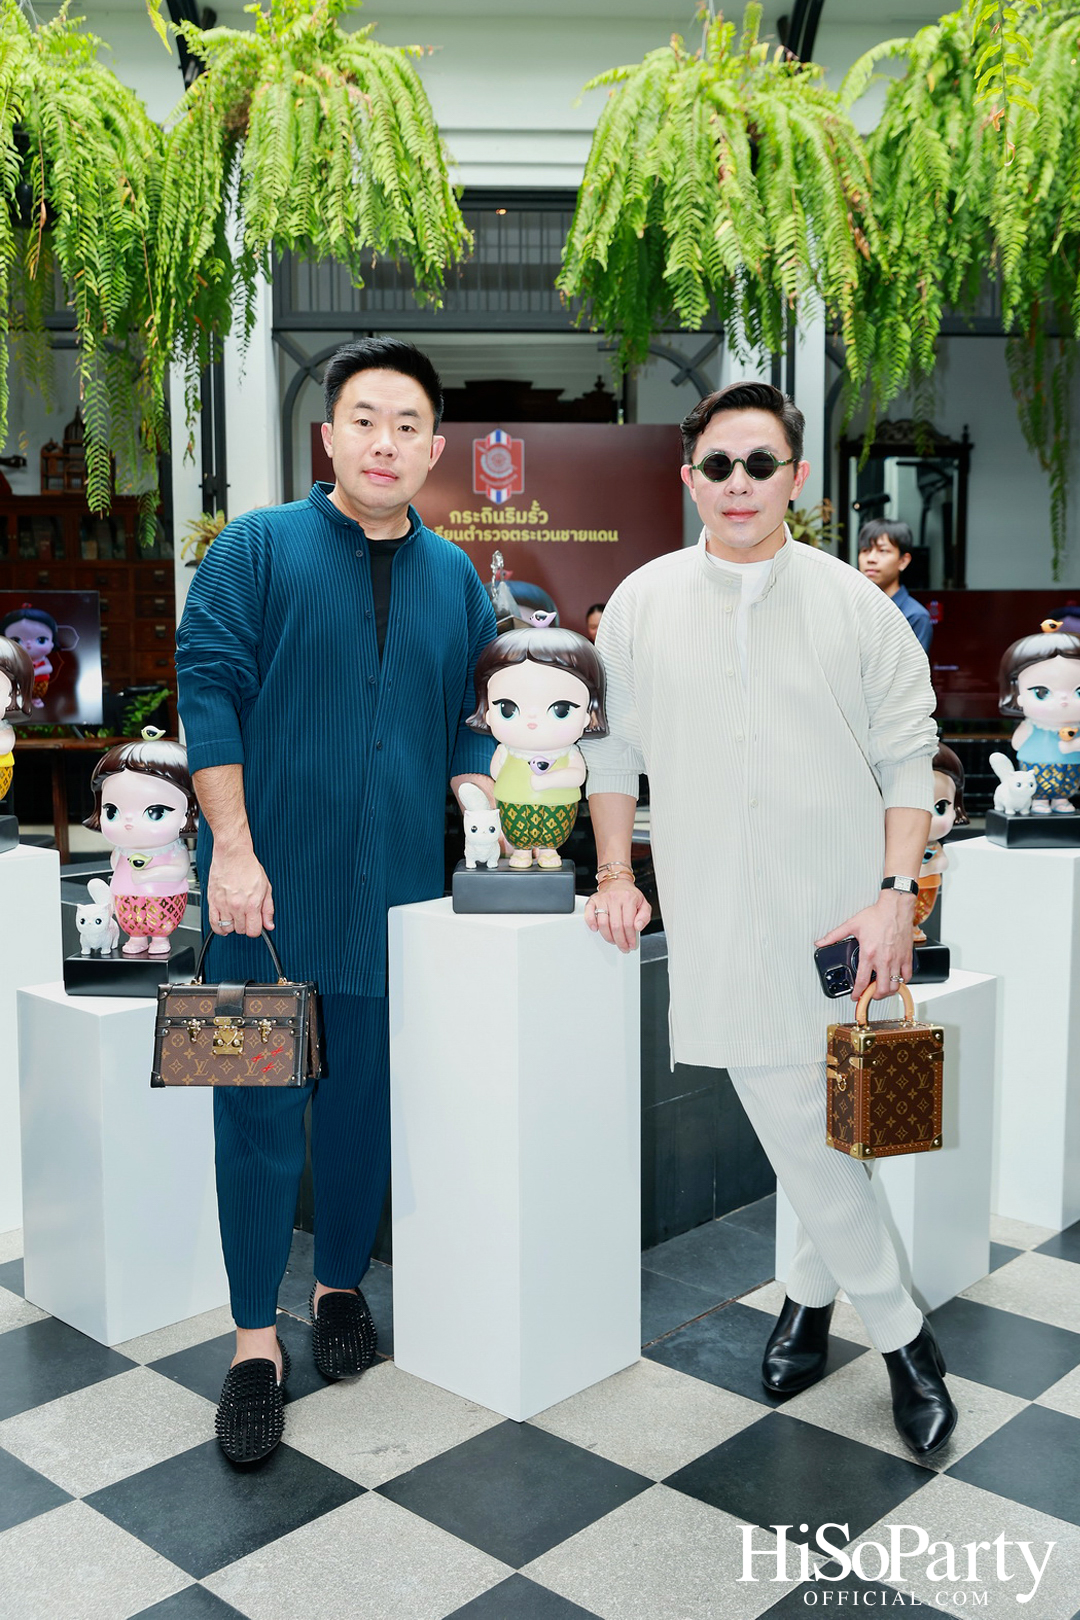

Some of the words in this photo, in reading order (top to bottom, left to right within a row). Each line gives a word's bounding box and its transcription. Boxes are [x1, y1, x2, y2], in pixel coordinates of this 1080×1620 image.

[449, 500, 549, 525] กระถินริมรั้ว
